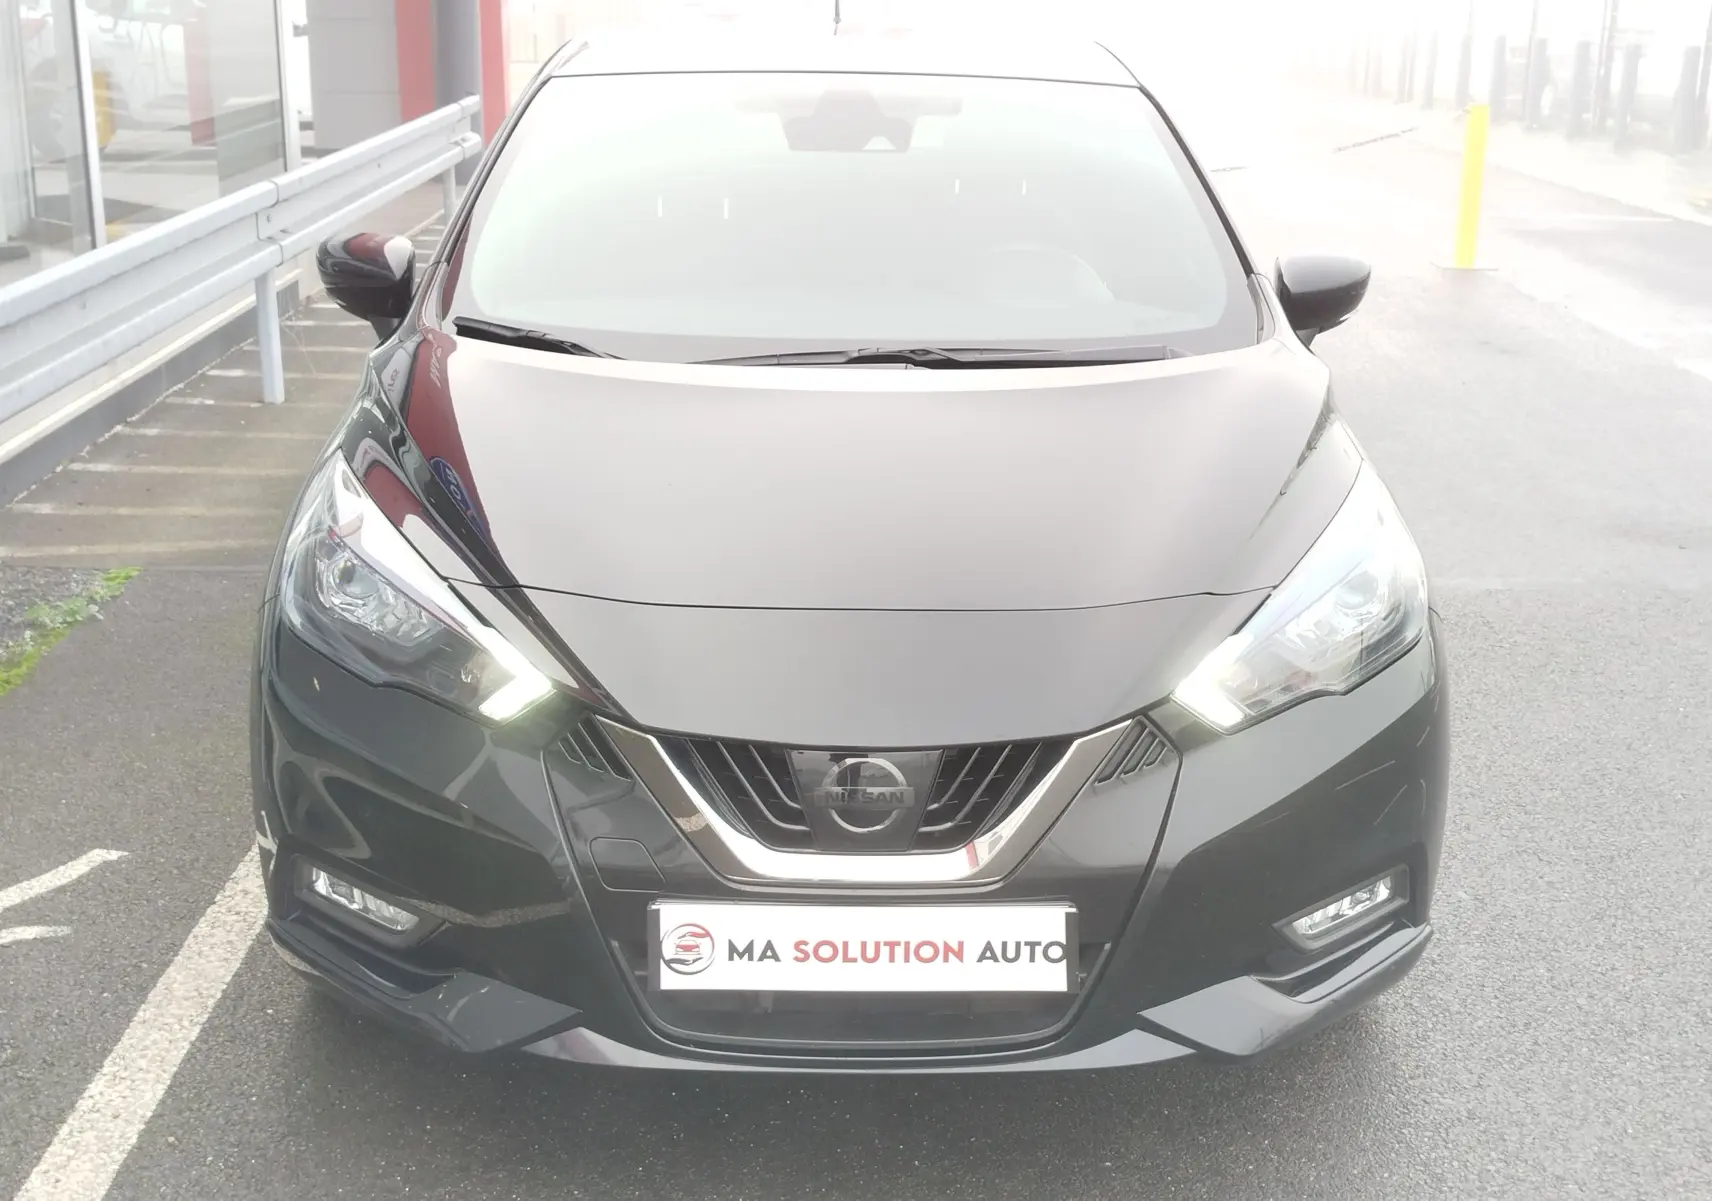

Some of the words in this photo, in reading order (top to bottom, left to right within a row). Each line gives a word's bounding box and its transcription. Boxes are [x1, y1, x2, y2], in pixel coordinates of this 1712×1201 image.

[825, 791, 905, 804] NISSAN
[727, 939, 781, 962] MA
[793, 940, 964, 963] SOLUTION
[976, 940, 1067, 963] AUTO
